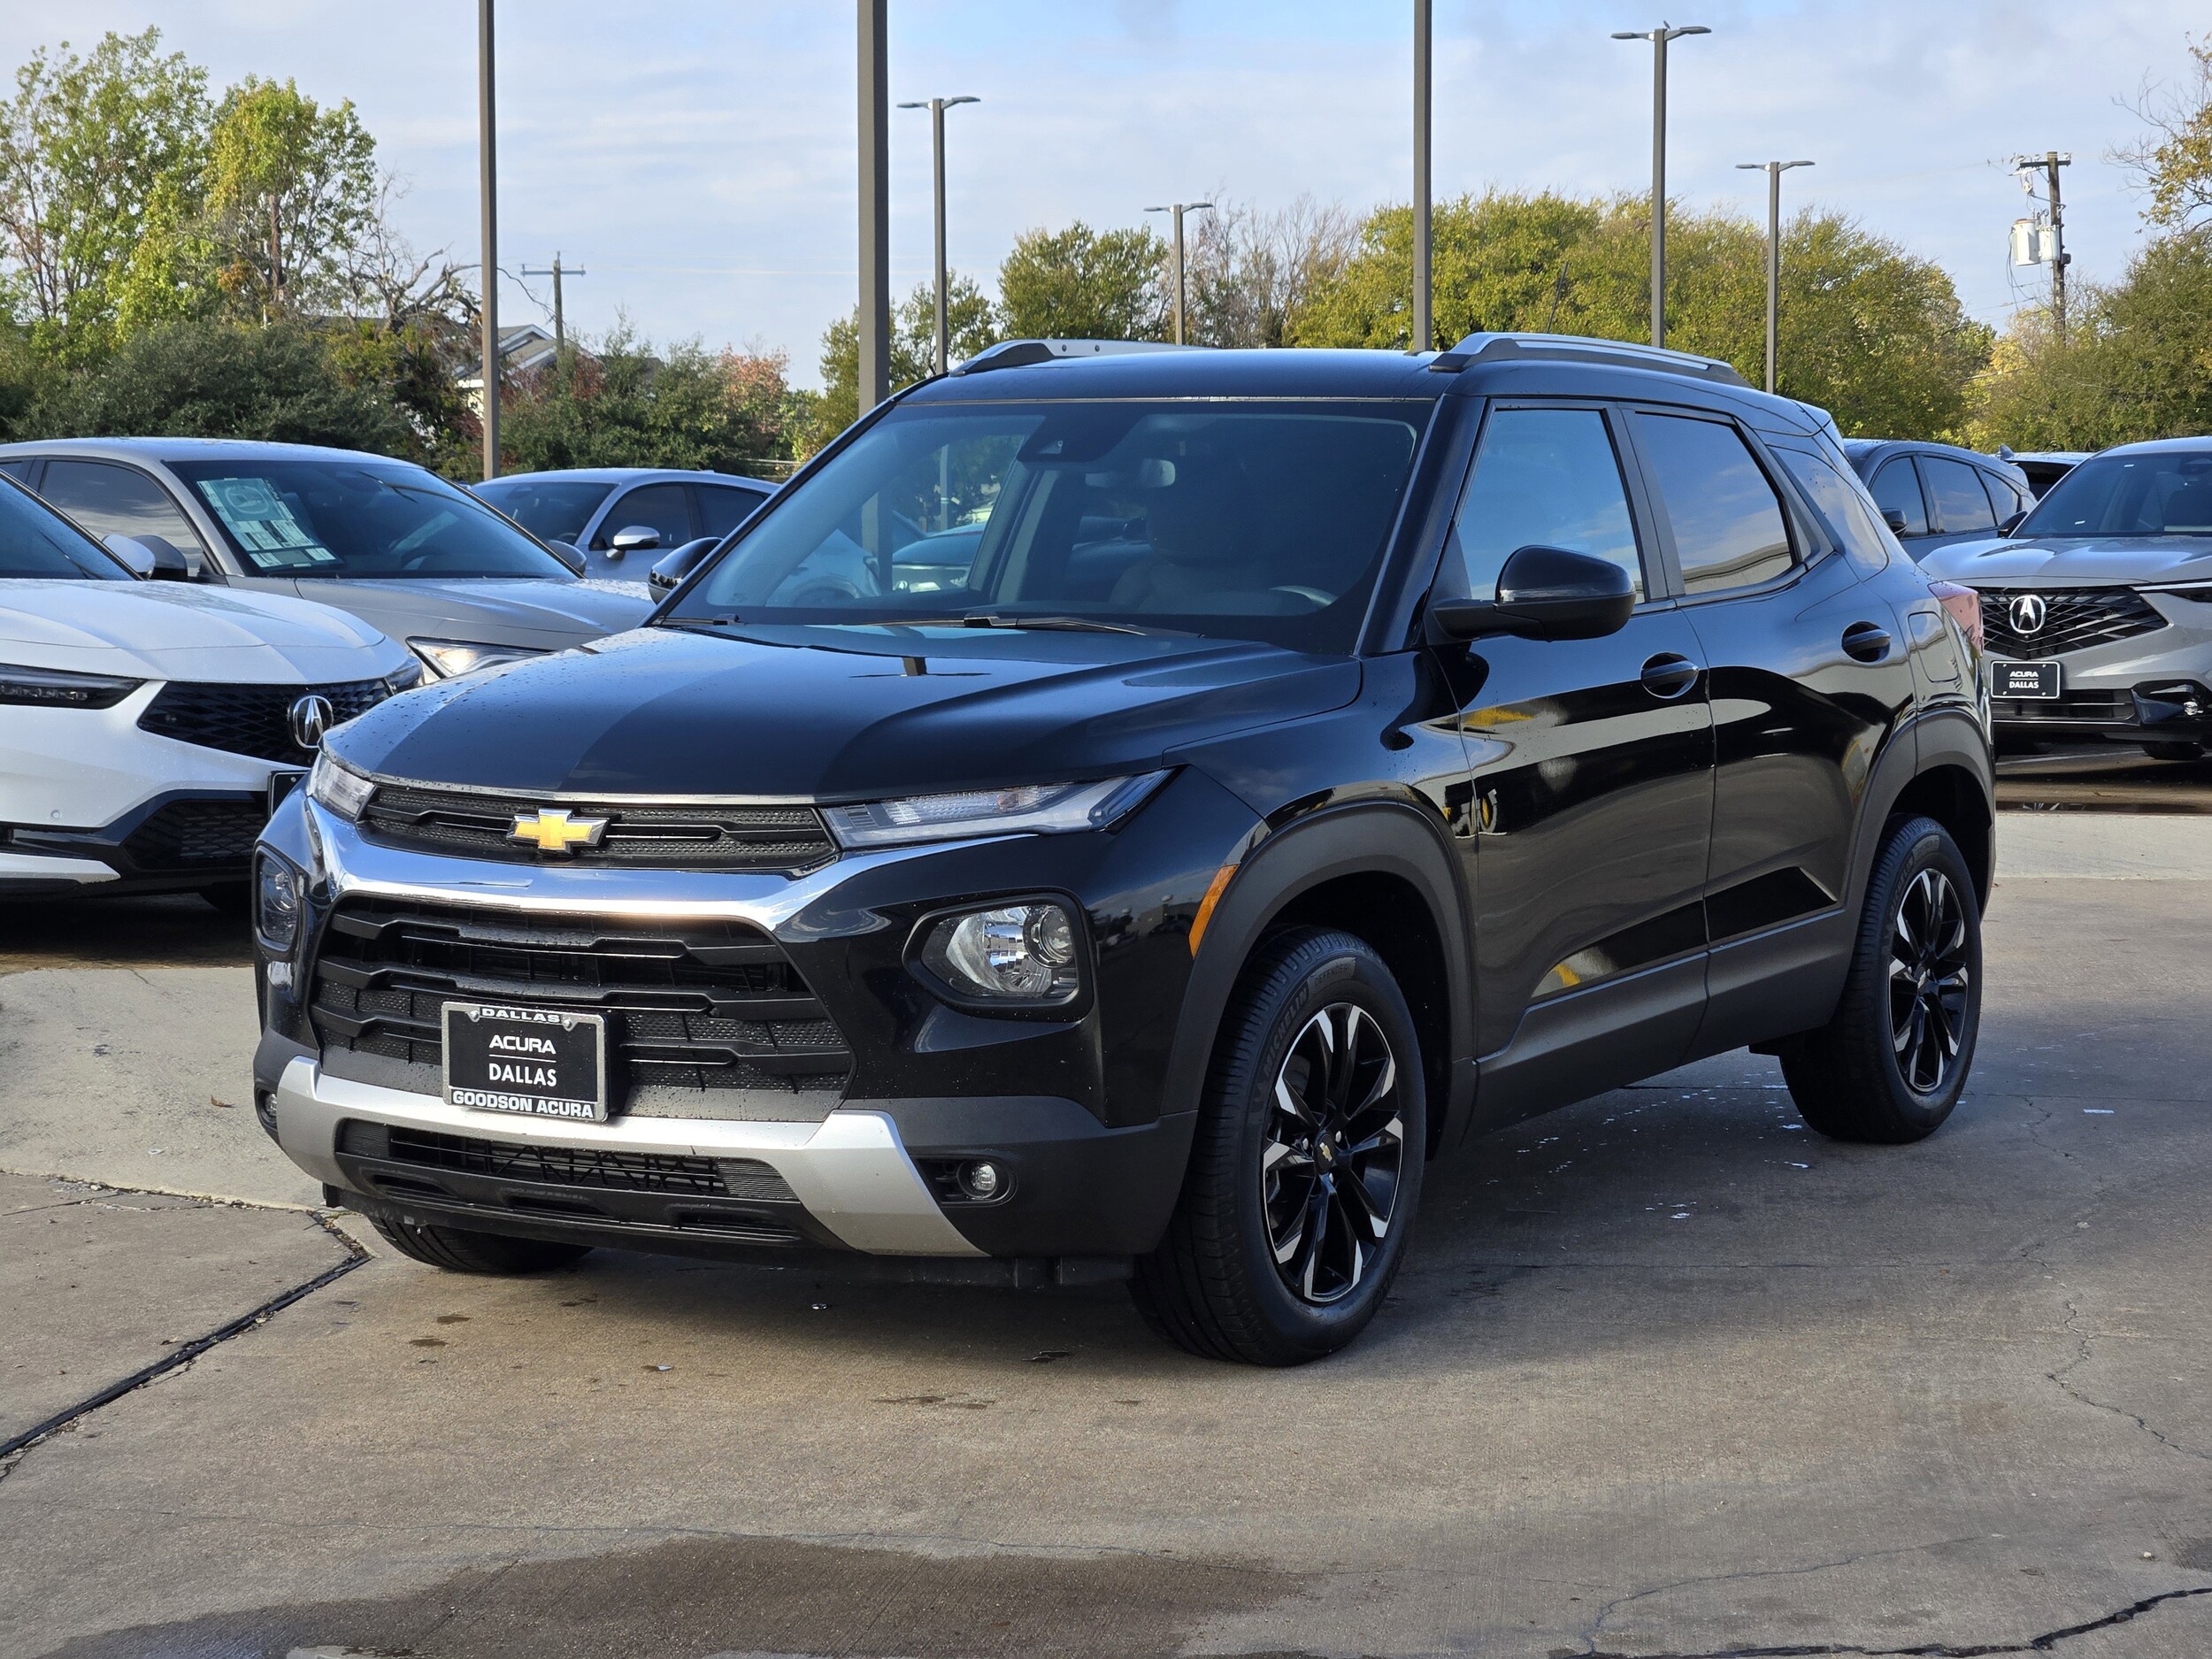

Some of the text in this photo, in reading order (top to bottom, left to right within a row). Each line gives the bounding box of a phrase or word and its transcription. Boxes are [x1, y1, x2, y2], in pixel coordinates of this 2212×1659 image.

[2008, 680, 2039, 689] DALLAS
[481, 1008, 561, 1024] DALLAS
[1263, 987, 1308, 1078] MICHELIN
[488, 1034, 557, 1055] ACURA
[488, 1063, 557, 1087] DALLAS
[452, 1090, 594, 1118] GOODSON ACURA
